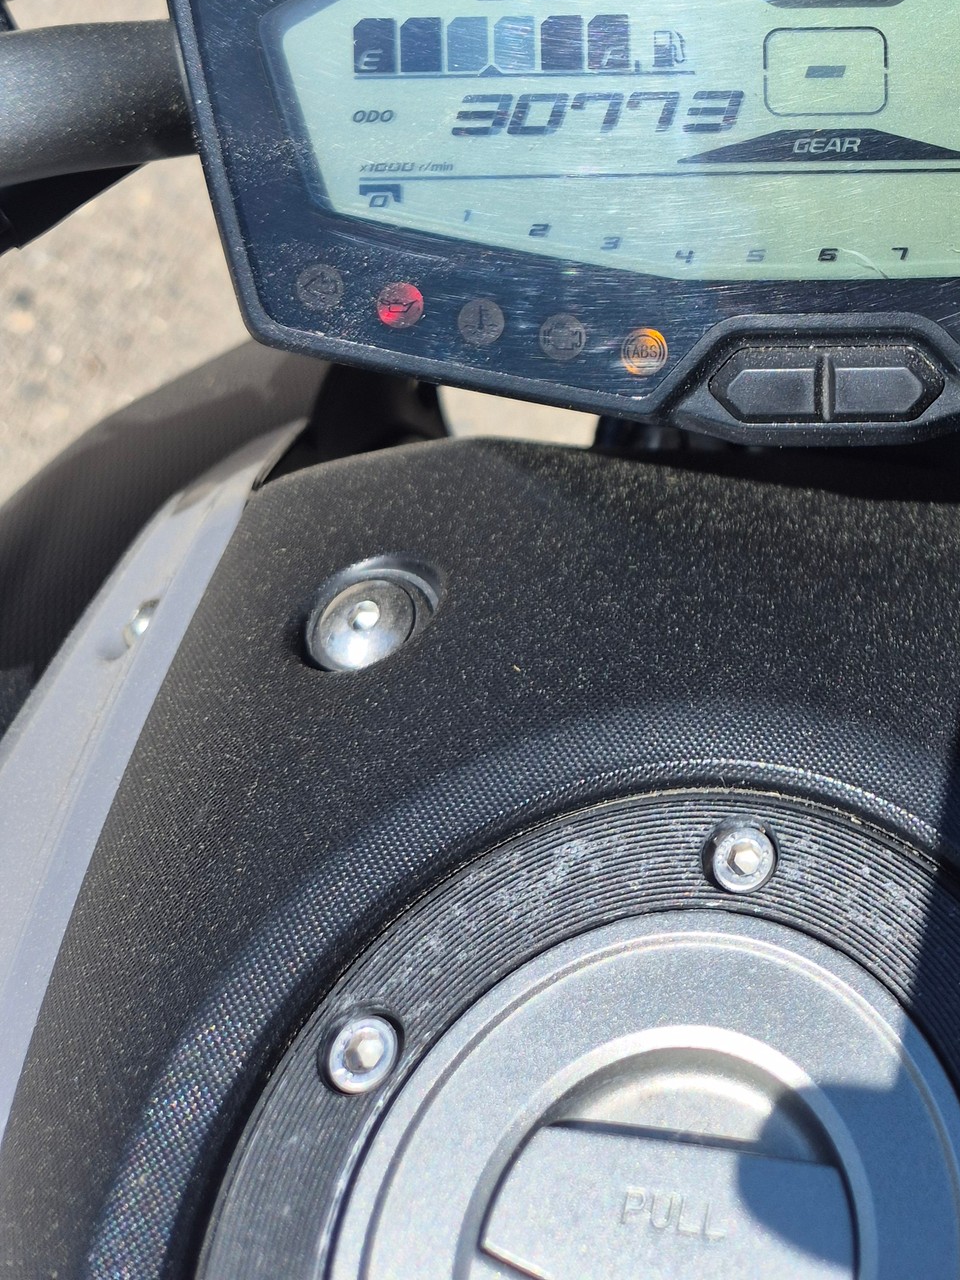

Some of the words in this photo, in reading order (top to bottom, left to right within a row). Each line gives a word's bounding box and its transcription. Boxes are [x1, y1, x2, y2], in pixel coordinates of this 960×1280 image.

[358, 48, 383, 70] E
[352, 109, 396, 123] ODO
[451, 90, 746, 136] 30773
[793, 137, 861, 153] GEAR
[369, 194, 390, 208] 0
[463, 209, 473, 222] 1
[528, 223, 551, 237] 2
[600, 236, 621, 251] 3
[675, 250, 695, 264] 4
[746, 249, 767, 263] 5
[817, 247, 839, 262] 6
[891, 247, 909, 261] 7
[631, 343, 658, 359] ABS
[619, 1186, 728, 1240] PULL
